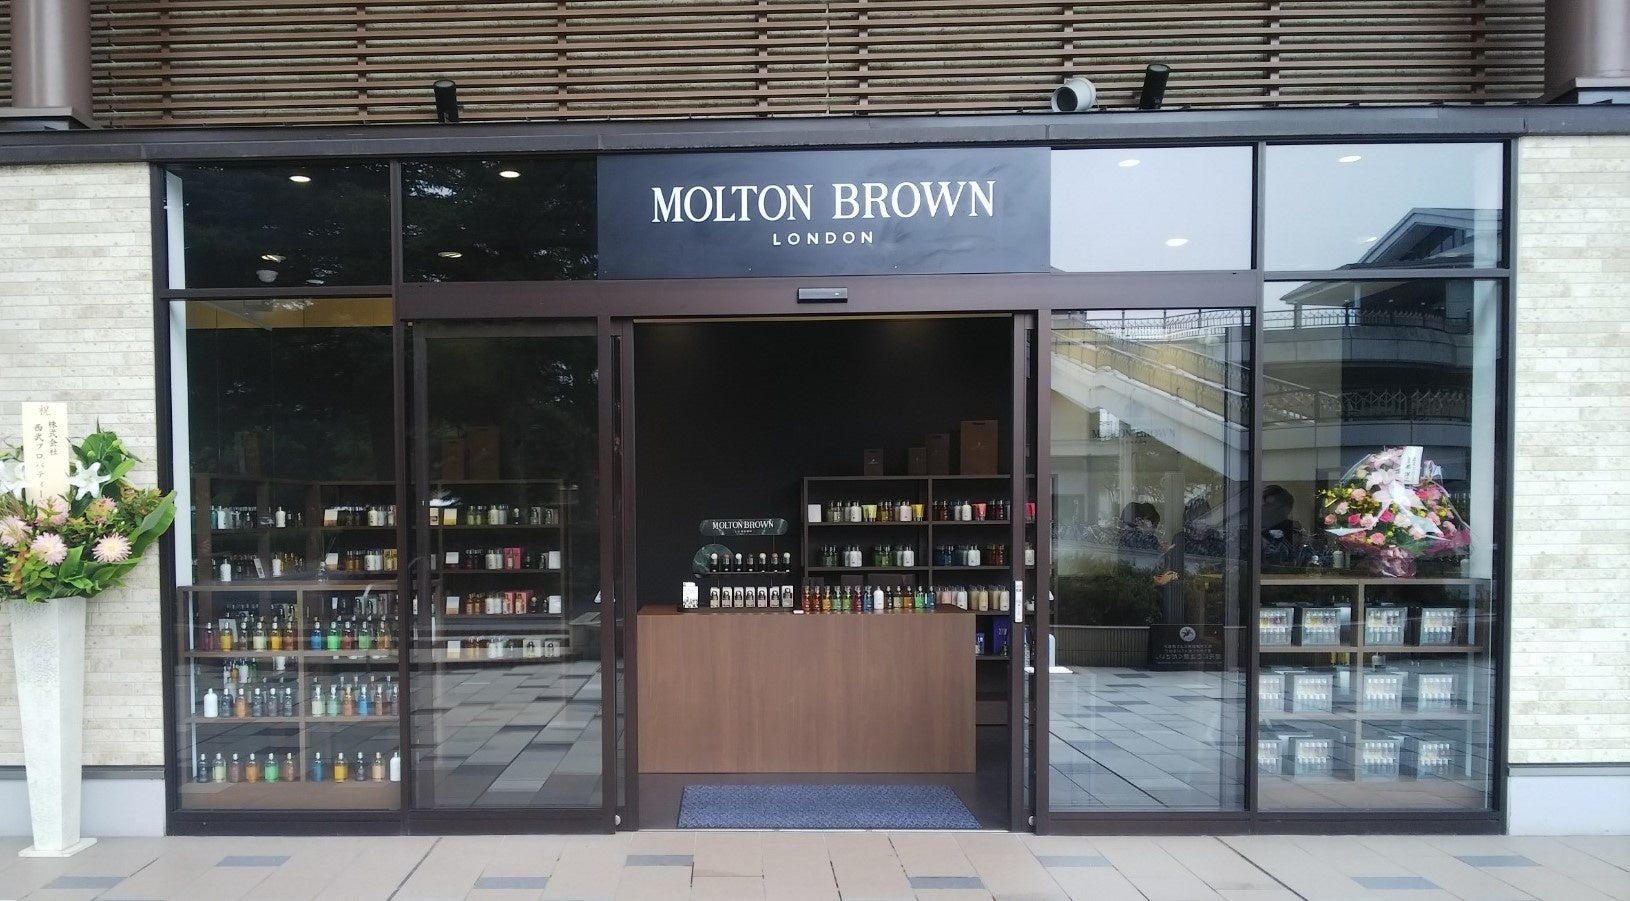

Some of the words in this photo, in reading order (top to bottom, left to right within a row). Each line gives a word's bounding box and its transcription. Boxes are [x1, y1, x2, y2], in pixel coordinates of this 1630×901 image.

[652, 184, 814, 223] MOLTON
[832, 180, 997, 220] BROWN
[773, 230, 874, 246] LONDON
[39, 405, 51, 416] 祝
[49, 421, 58, 456] 株式会社
[1090, 429, 1131, 439] MON
[713, 521, 743, 529] MOLTON
[744, 520, 774, 528] BROWN
